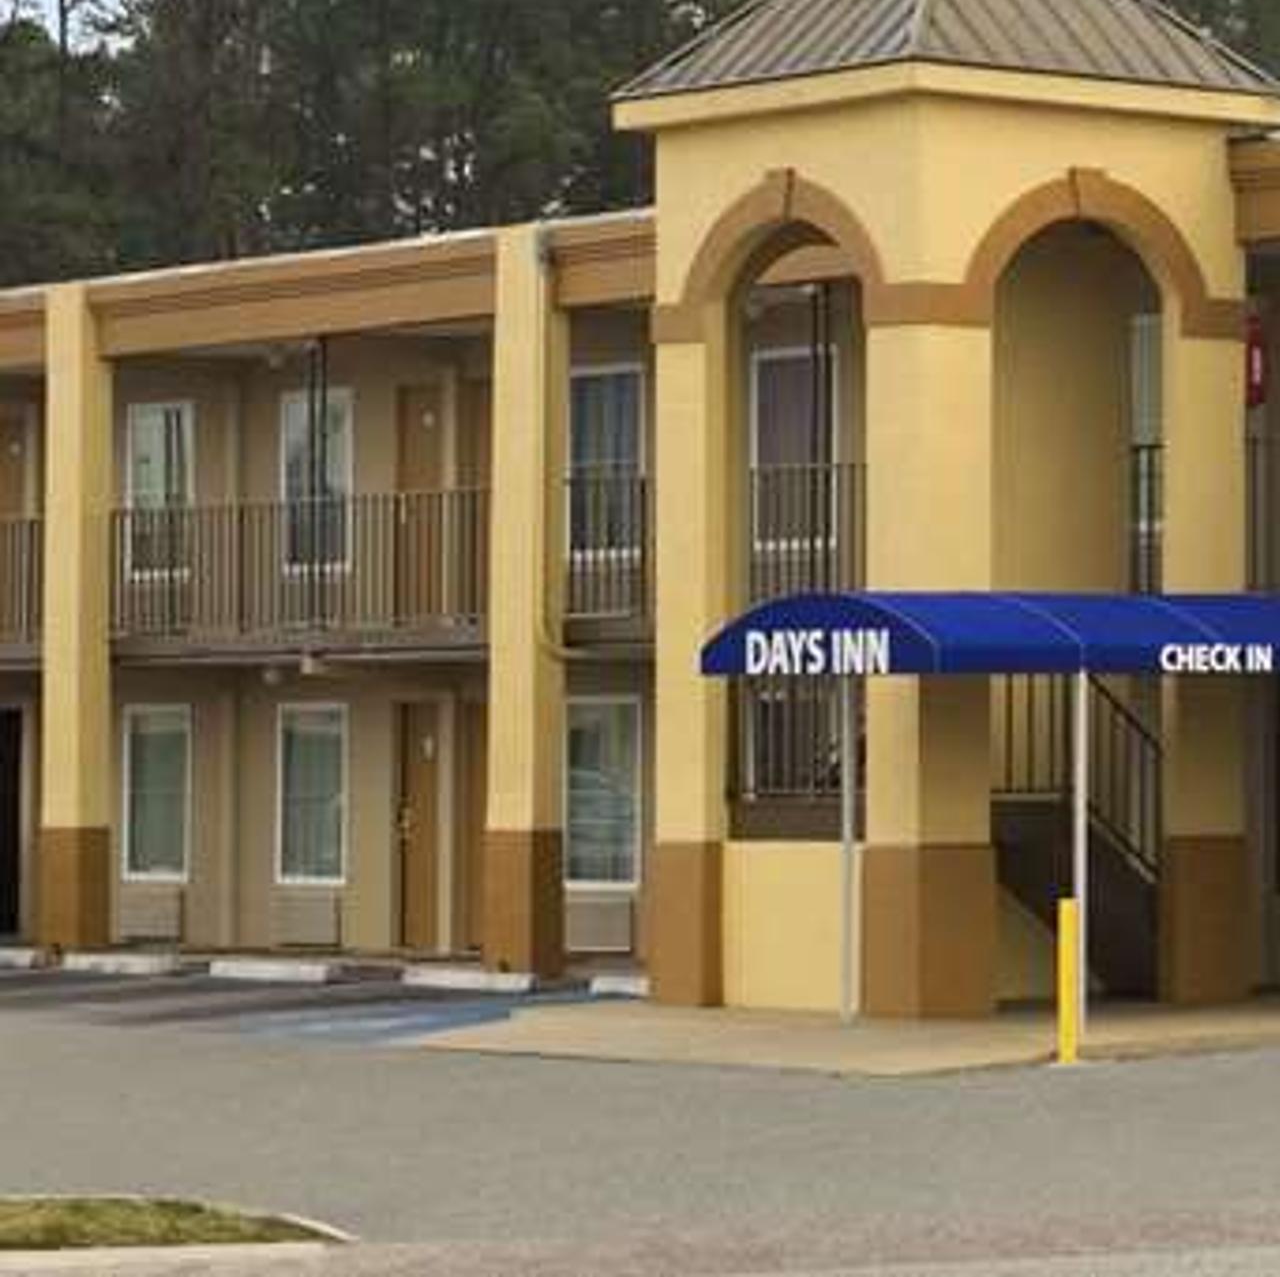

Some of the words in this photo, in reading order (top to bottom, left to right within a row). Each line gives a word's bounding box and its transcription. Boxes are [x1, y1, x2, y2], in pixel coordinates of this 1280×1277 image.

[746, 629, 824, 674] DAYS
[832, 629, 889, 674] INN
[1161, 643, 1240, 673] CHECK
[1246, 643, 1272, 673] IN
